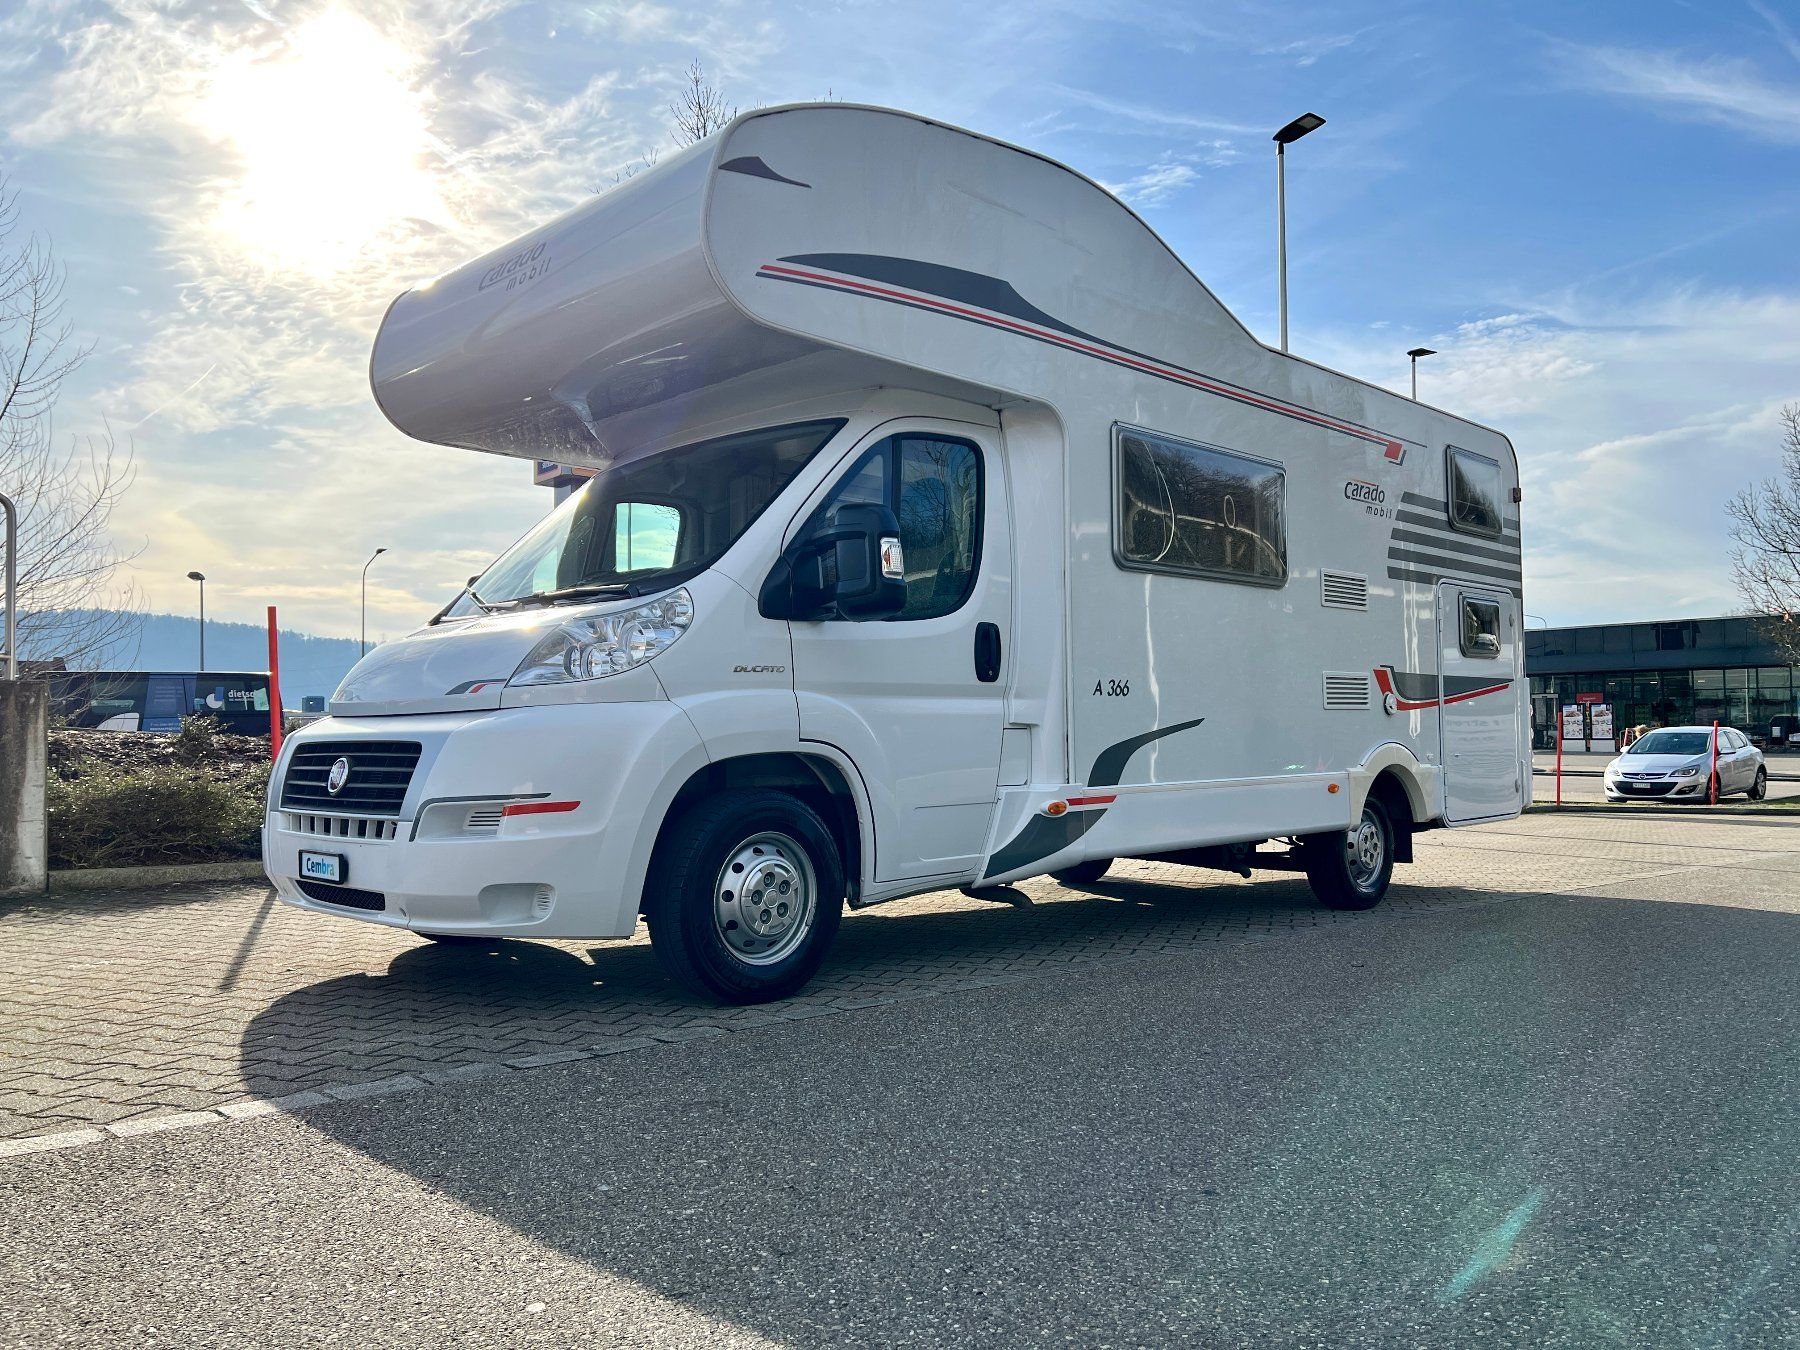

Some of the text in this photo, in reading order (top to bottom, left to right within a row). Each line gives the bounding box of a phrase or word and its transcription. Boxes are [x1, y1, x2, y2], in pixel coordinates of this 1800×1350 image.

[506, 256, 552, 291] mobil
[1365, 505, 1393, 519] mobil
[733, 665, 786, 673] DUCATO
[1092, 679, 1130, 697] A 366
[306, 857, 336, 877] Cembra
